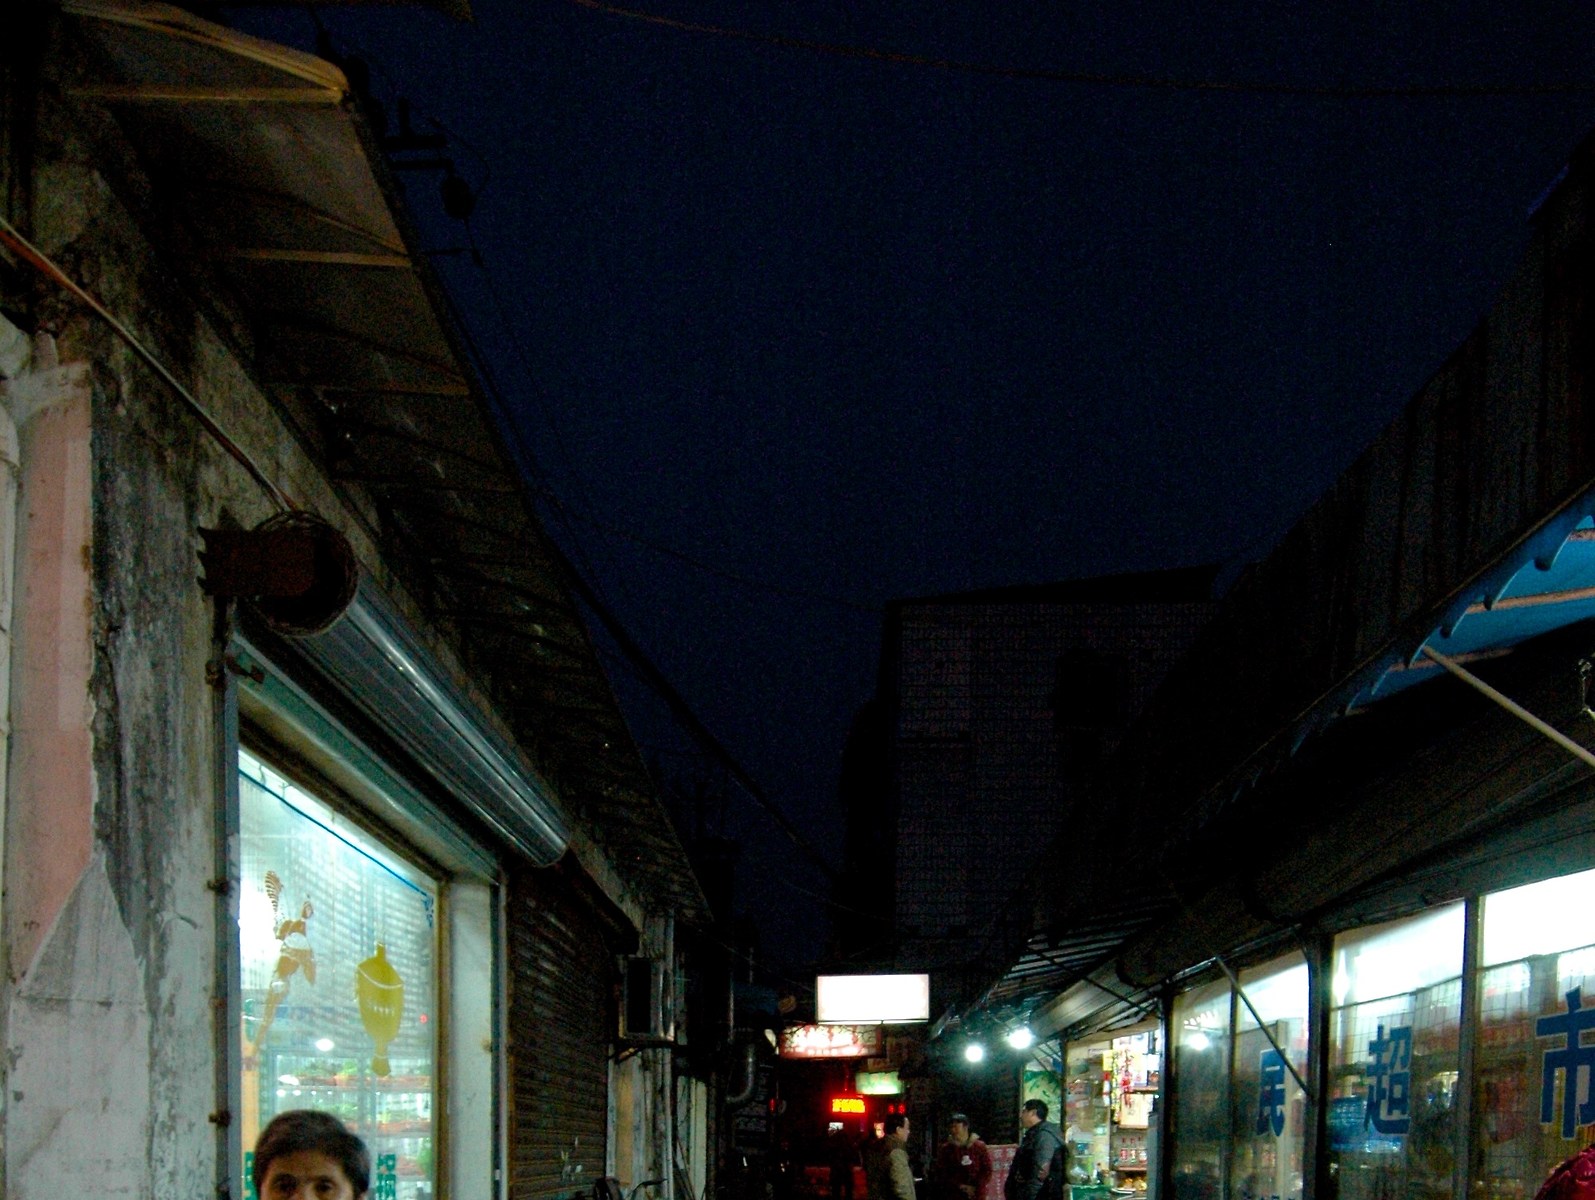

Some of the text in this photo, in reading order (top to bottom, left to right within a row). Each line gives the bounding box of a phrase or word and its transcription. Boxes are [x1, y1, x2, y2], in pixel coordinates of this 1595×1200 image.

[1257, 1048, 1286, 1137] 民
[1363, 1024, 1412, 1135] 超
[1536, 987, 1595, 1141] 市
